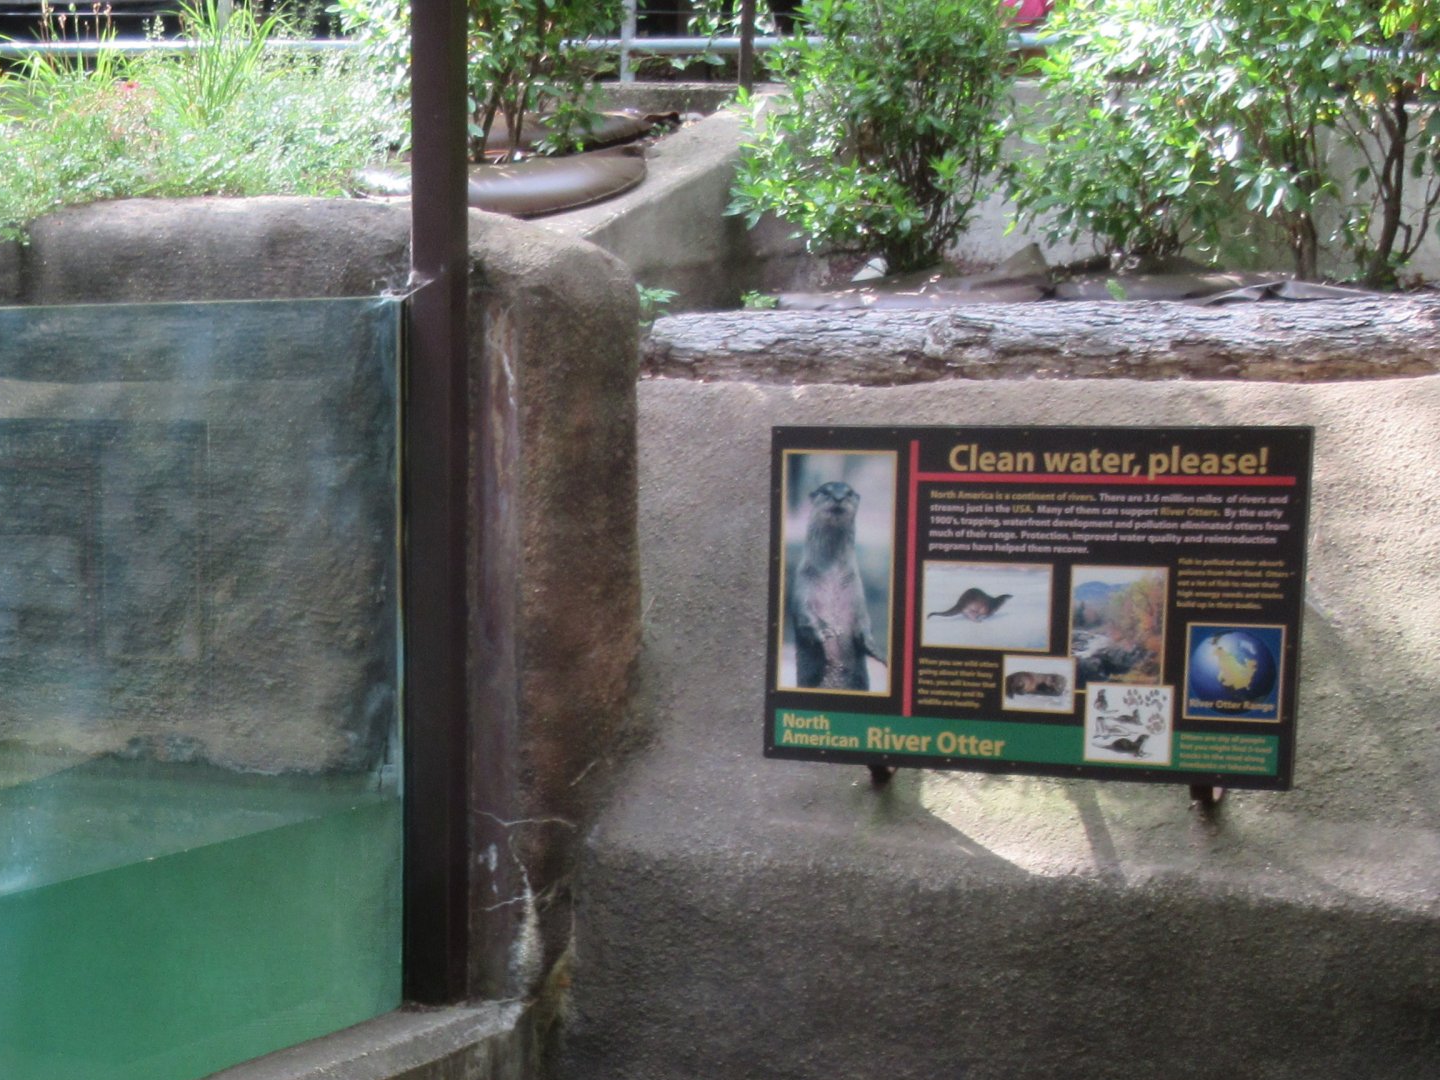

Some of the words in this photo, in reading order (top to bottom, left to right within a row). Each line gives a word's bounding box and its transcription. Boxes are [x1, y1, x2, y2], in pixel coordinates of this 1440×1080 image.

[948, 443, 1034, 473] Clean
[1043, 448, 1141, 477] water,
[1148, 446, 1269, 481] please!
[931, 490, 957, 500] North
[958, 490, 994, 500] America
[996, 490, 1003, 500] is
[1012, 492, 1055, 501] continent
[1056, 492, 1067, 501] of
[1068, 493, 1096, 502] rivers.
[1100, 493, 1126, 502] There
[1161, 494, 1195, 503] million
[1196, 494, 1223, 503] miles
[1226, 495, 1238, 503] of
[1239, 495, 1266, 503] rivers
[1269, 496, 1288, 504] and
[930, 504, 965, 512] streams
[966, 503, 984, 514] just
[985, 504, 994, 512] in
[995, 504, 1010, 513] the
[1012, 505, 1034, 513] USA.
[1037, 505, 1062, 515] Many
[1064, 506, 1075, 514] of
[1076, 506, 1100, 514] them
[1120, 508, 1158, 517] support
[1160, 507, 1185, 516] River
[1187, 507, 1221, 517] Otters.
[1224, 508, 1237, 518] By
[1239, 508, 1256, 517] the
[1258, 509, 1283, 519] early
[961, 517, 1001, 528] trapping,
[1003, 517, 1051, 526] waterfront
[1052, 519, 1113, 529] development
[1115, 520, 1133, 528] and
[1134, 520, 1178, 530] pollution
[1180, 520, 1232, 530] eliminated
[1234, 522, 1264, 530] otters
[1266, 522, 1290, 531] from
[929, 529, 953, 537] much
[955, 529, 965, 538] of
[966, 529, 988, 538] their
[989, 531, 1018, 541] range.
[1072, 532, 1118, 542] improved
[1119, 534, 1146, 542] water
[1147, 533, 1182, 544] quality
[1184, 534, 1203, 543] and
[1204, 534, 1277, 544] reintroduction
[929, 543, 971, 552] programs
[972, 543, 993, 551] have
[995, 543, 1027, 554] helped
[1028, 544, 1052, 552] them
[782, 713, 829, 730] North
[782, 729, 860, 748] American
[866, 727, 932, 752] River
[936, 731, 1006, 757] Otter
